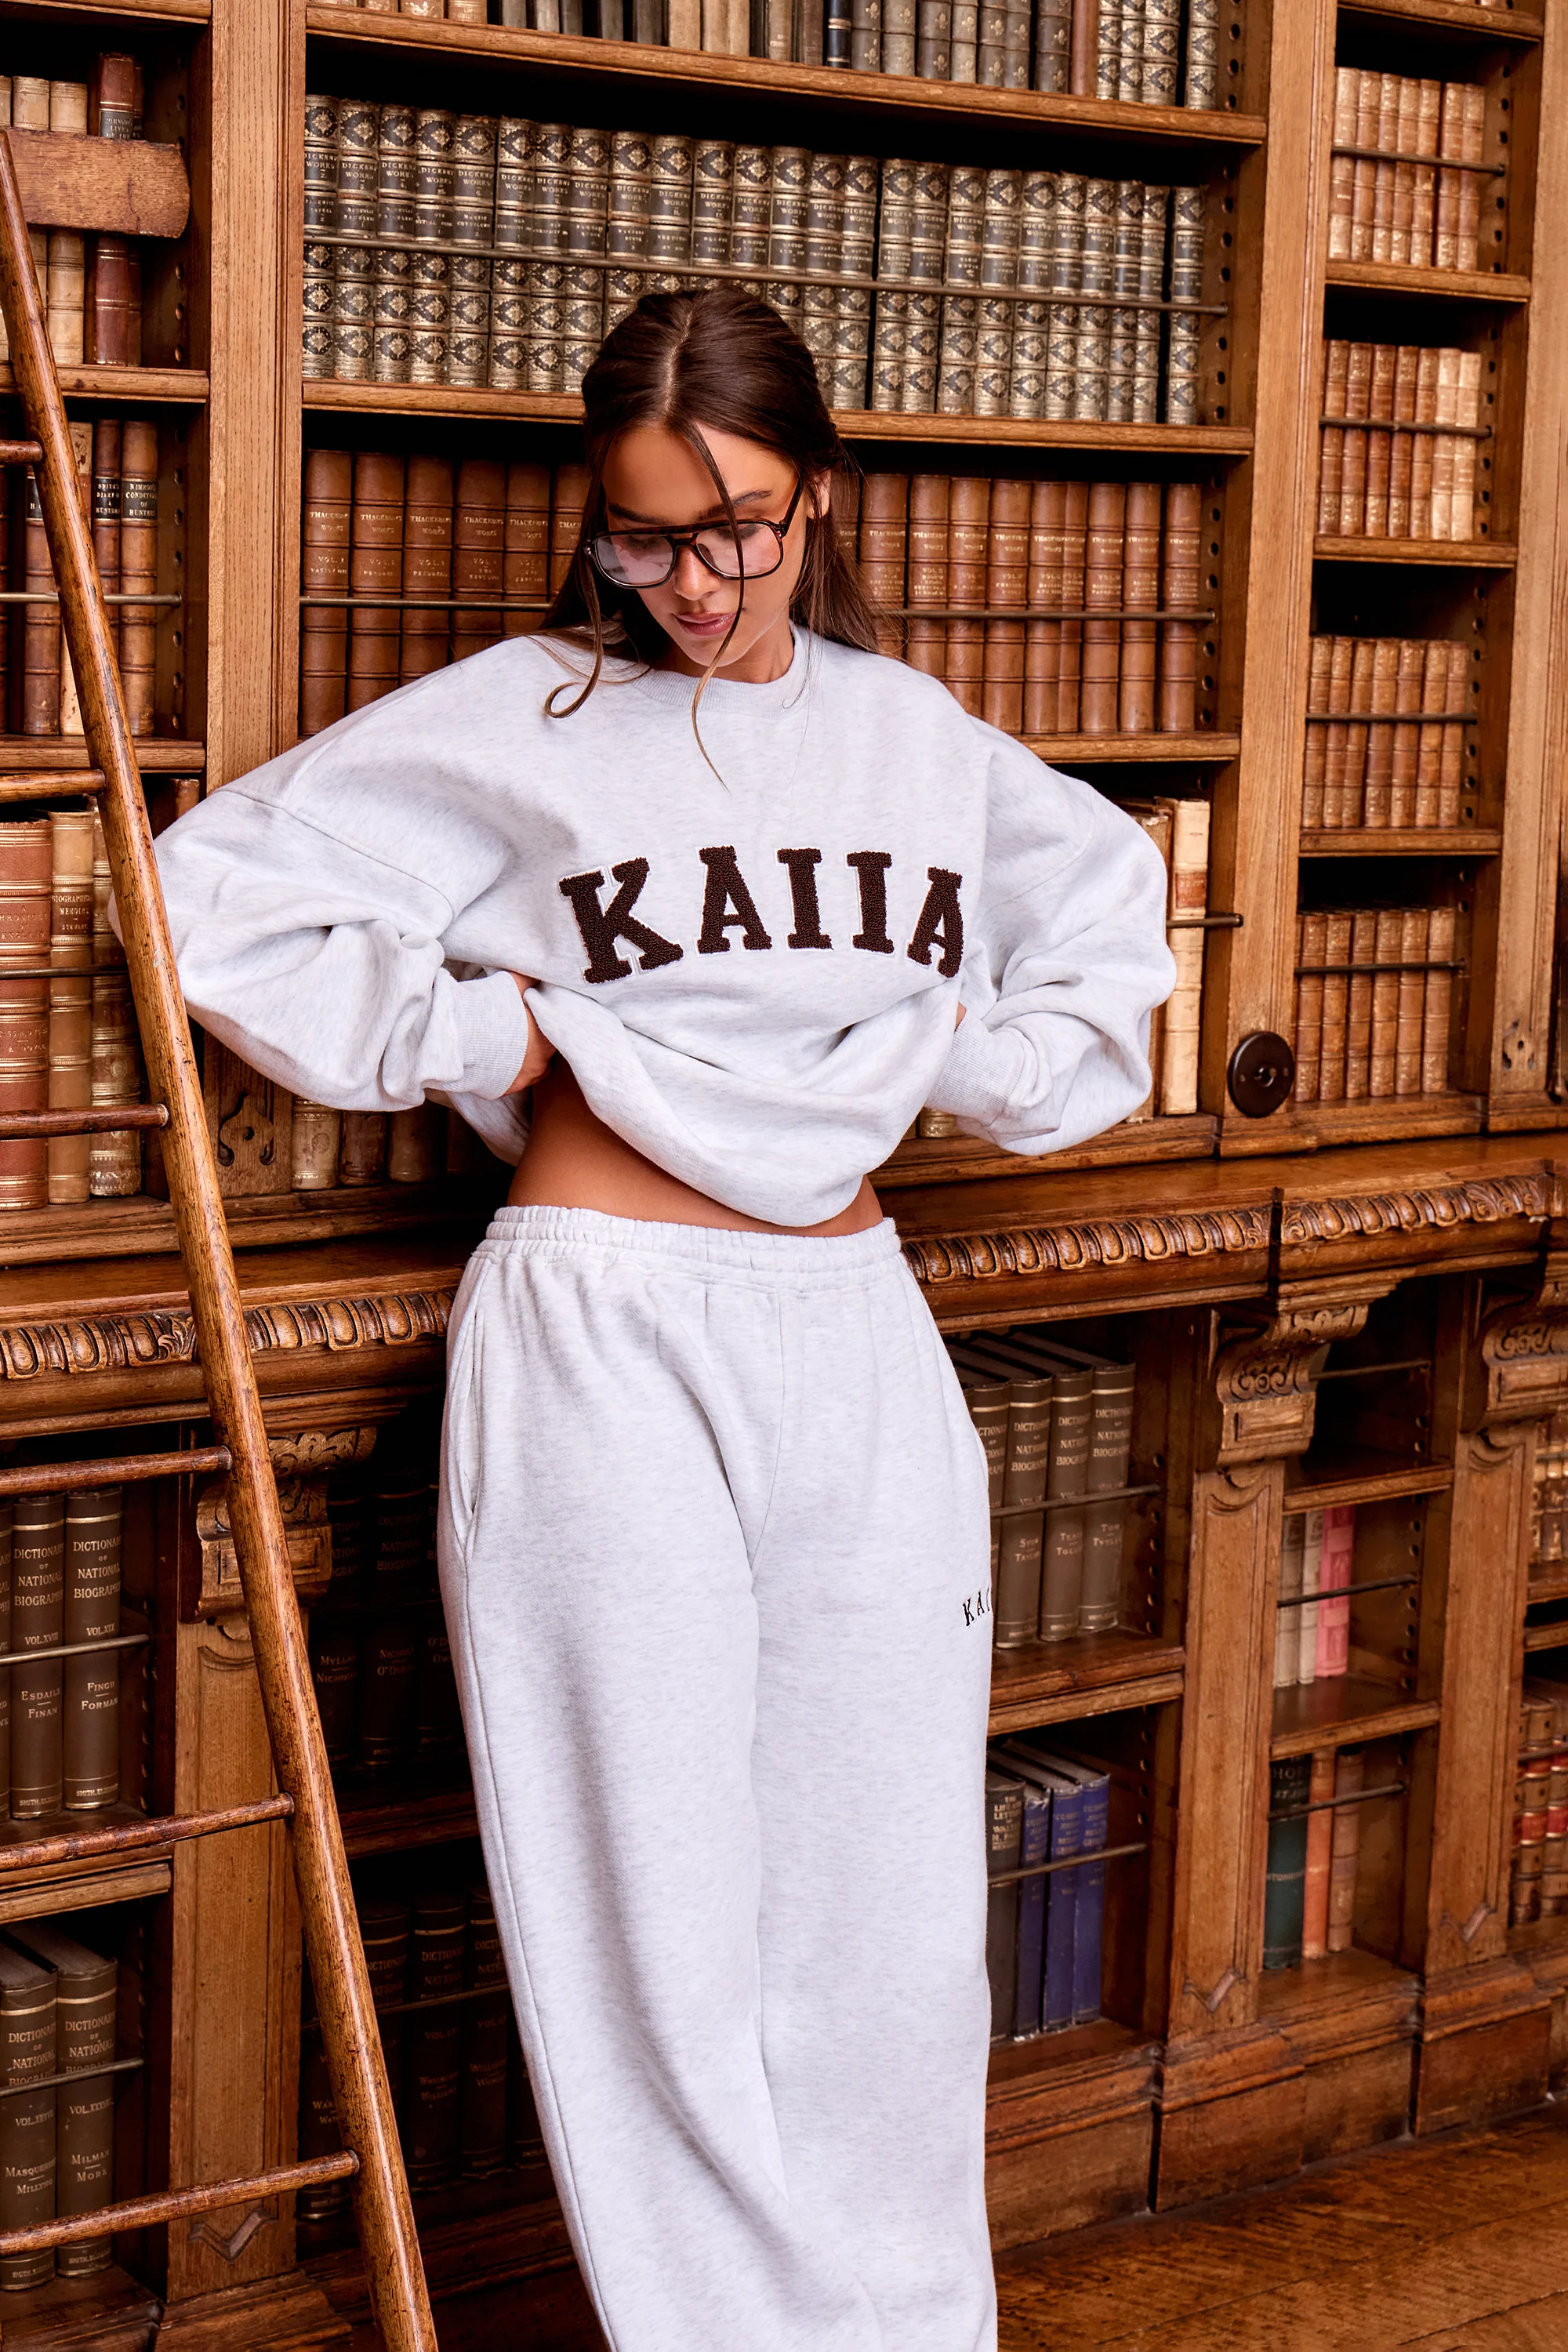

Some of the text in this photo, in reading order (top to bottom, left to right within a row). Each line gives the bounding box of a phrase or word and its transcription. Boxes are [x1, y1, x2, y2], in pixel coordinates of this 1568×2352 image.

[558, 845, 964, 984] KAIIA
[18, 1571, 63, 1587] NATIONAL
[78, 1563, 121, 1579] NATIONAL
[15, 1589, 64, 1606] BIOGRAPHY
[74, 1581, 122, 1599] BIOGRAPHY
[28, 1707, 58, 1719] FINAN
[71, 2149, 110, 2165] MILMAN
